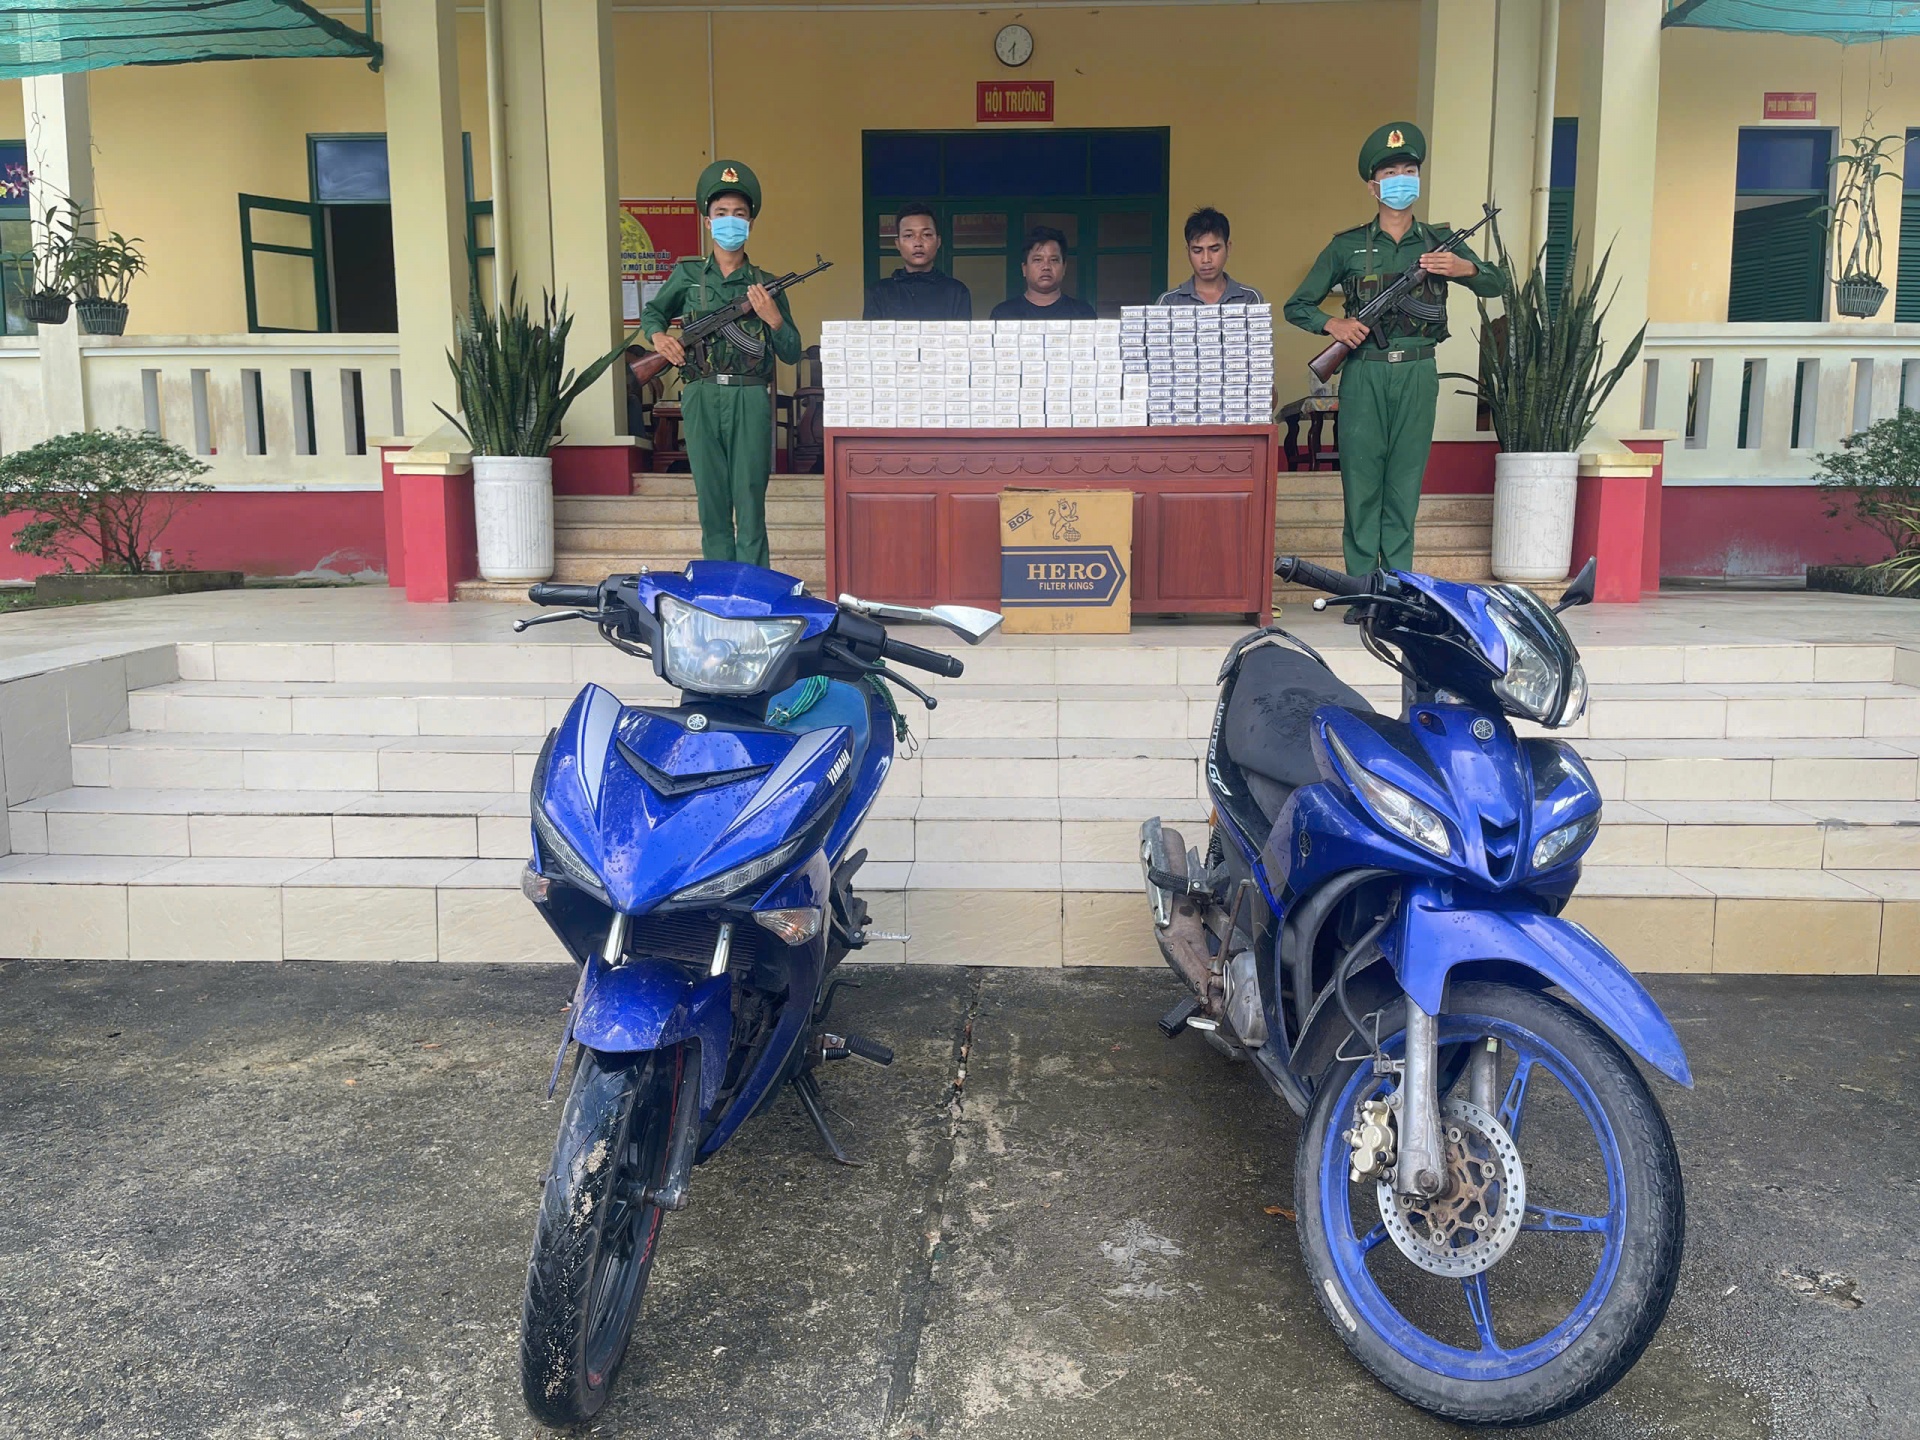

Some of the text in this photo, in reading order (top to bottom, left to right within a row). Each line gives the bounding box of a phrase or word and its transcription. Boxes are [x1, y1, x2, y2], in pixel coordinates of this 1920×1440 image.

[984, 86, 1046, 116] HỘI TRƯỜNG
[1008, 510, 1032, 529] BOX
[1027, 563, 1107, 580] HERO
[1039, 582, 1094, 590] FILTER KINGS
[1209, 699, 1232, 796] JUPITER GP
[826, 749, 850, 786] YAMAHA
